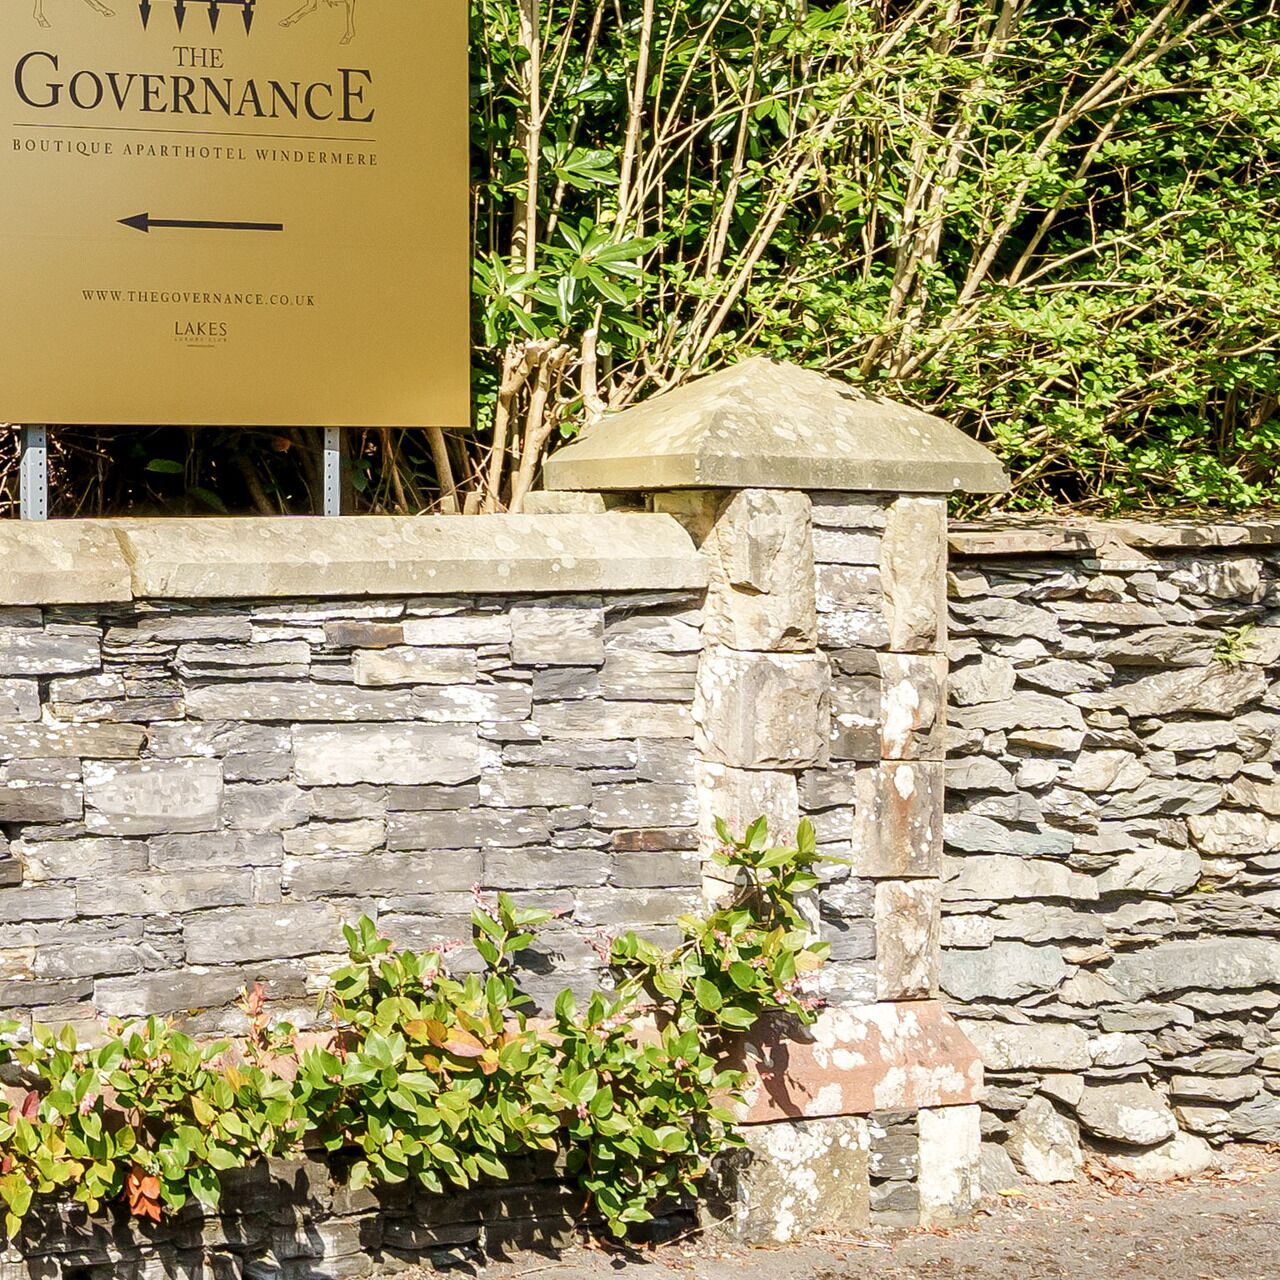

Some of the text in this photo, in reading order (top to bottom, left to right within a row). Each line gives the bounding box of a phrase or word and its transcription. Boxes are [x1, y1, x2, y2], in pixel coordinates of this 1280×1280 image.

[172, 45, 224, 69] THE
[14, 50, 375, 123] GOVERNANCE
[12, 138, 378, 166] BOUTIQUE APARTHOTEL WINDERMERE
[82, 289, 315, 306] WWW.THEGOVERNANCE.CO.UK
[175, 321, 227, 336] LAKES
